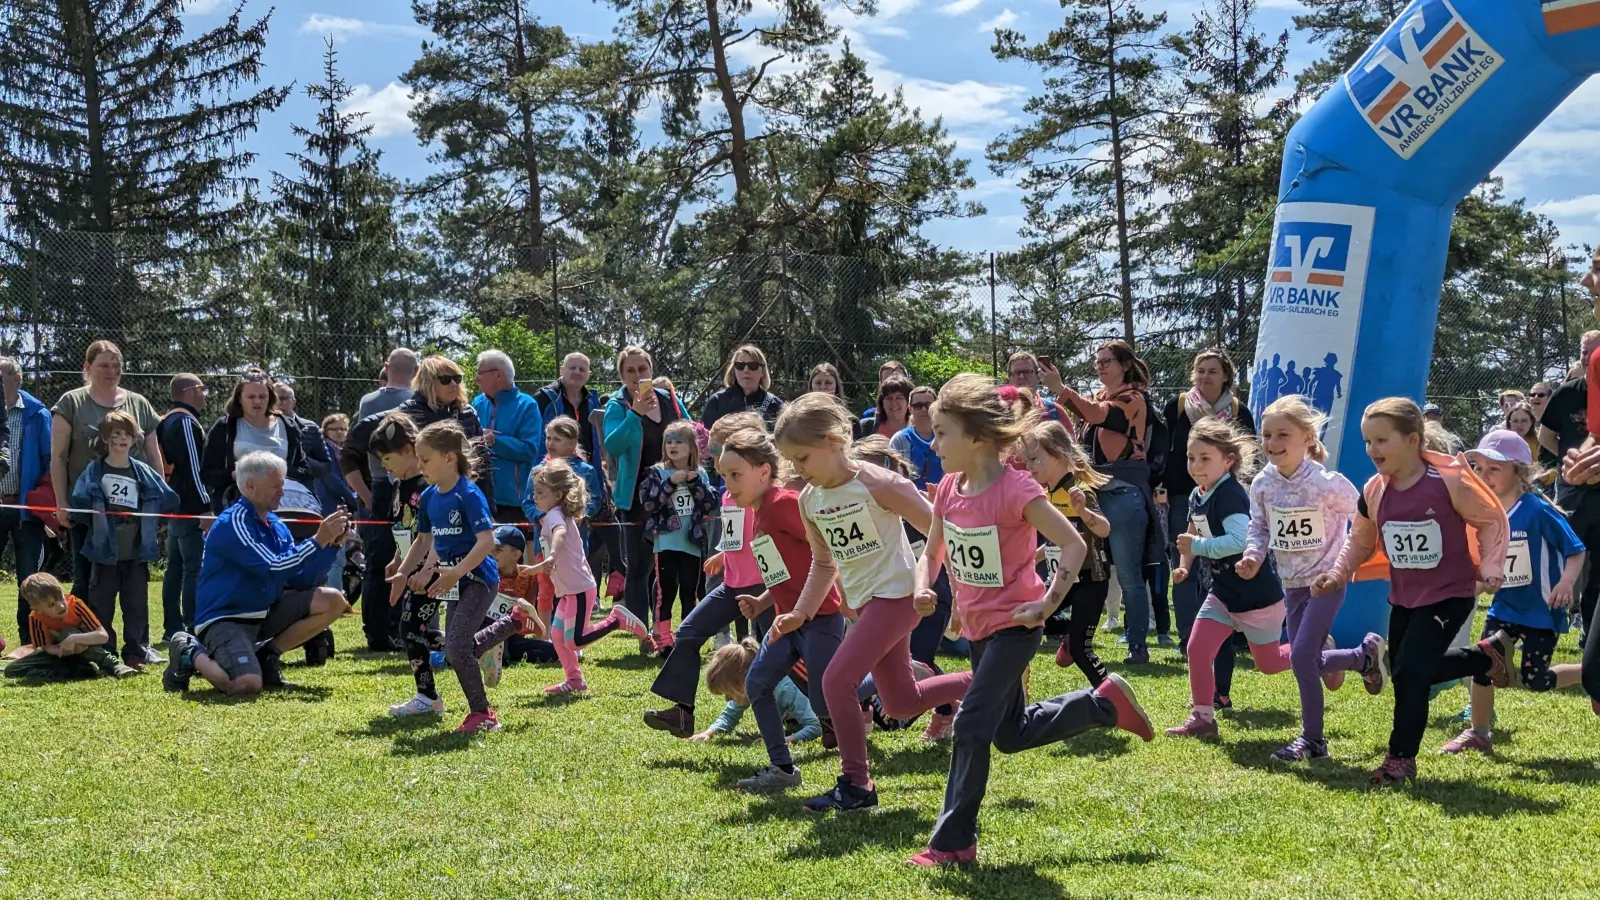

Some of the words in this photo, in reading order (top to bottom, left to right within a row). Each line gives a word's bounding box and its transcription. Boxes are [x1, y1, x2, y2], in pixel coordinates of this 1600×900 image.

[1379, 104, 1422, 140] VR
[1413, 37, 1486, 110] BANK
[1399, 67, 1482, 152] AMBERG-SULZBACH
[1480, 55, 1495, 71] EG
[1270, 287, 1284, 304] VR
[1287, 287, 1341, 308] BANK
[1327, 309, 1339, 317] EG
[111, 483, 128, 497] 24
[677, 495, 691, 507] 97
[431, 526, 463, 536] ONRAD
[826, 521, 864, 547] 234
[1277, 518, 1313, 538] 245
[1512, 530, 1528, 538] Mila
[843, 548, 855, 557] VR
[856, 540, 879, 552] BANK
[1393, 534, 1429, 552] 312
[948, 539, 985, 569] 219
[1420, 552, 1438, 561] BANK
[1505, 555, 1517, 573] 7
[769, 569, 787, 581] BANK
[963, 571, 973, 579] VR
[973, 572, 999, 580] BANK
[1508, 574, 1529, 582] BANK
